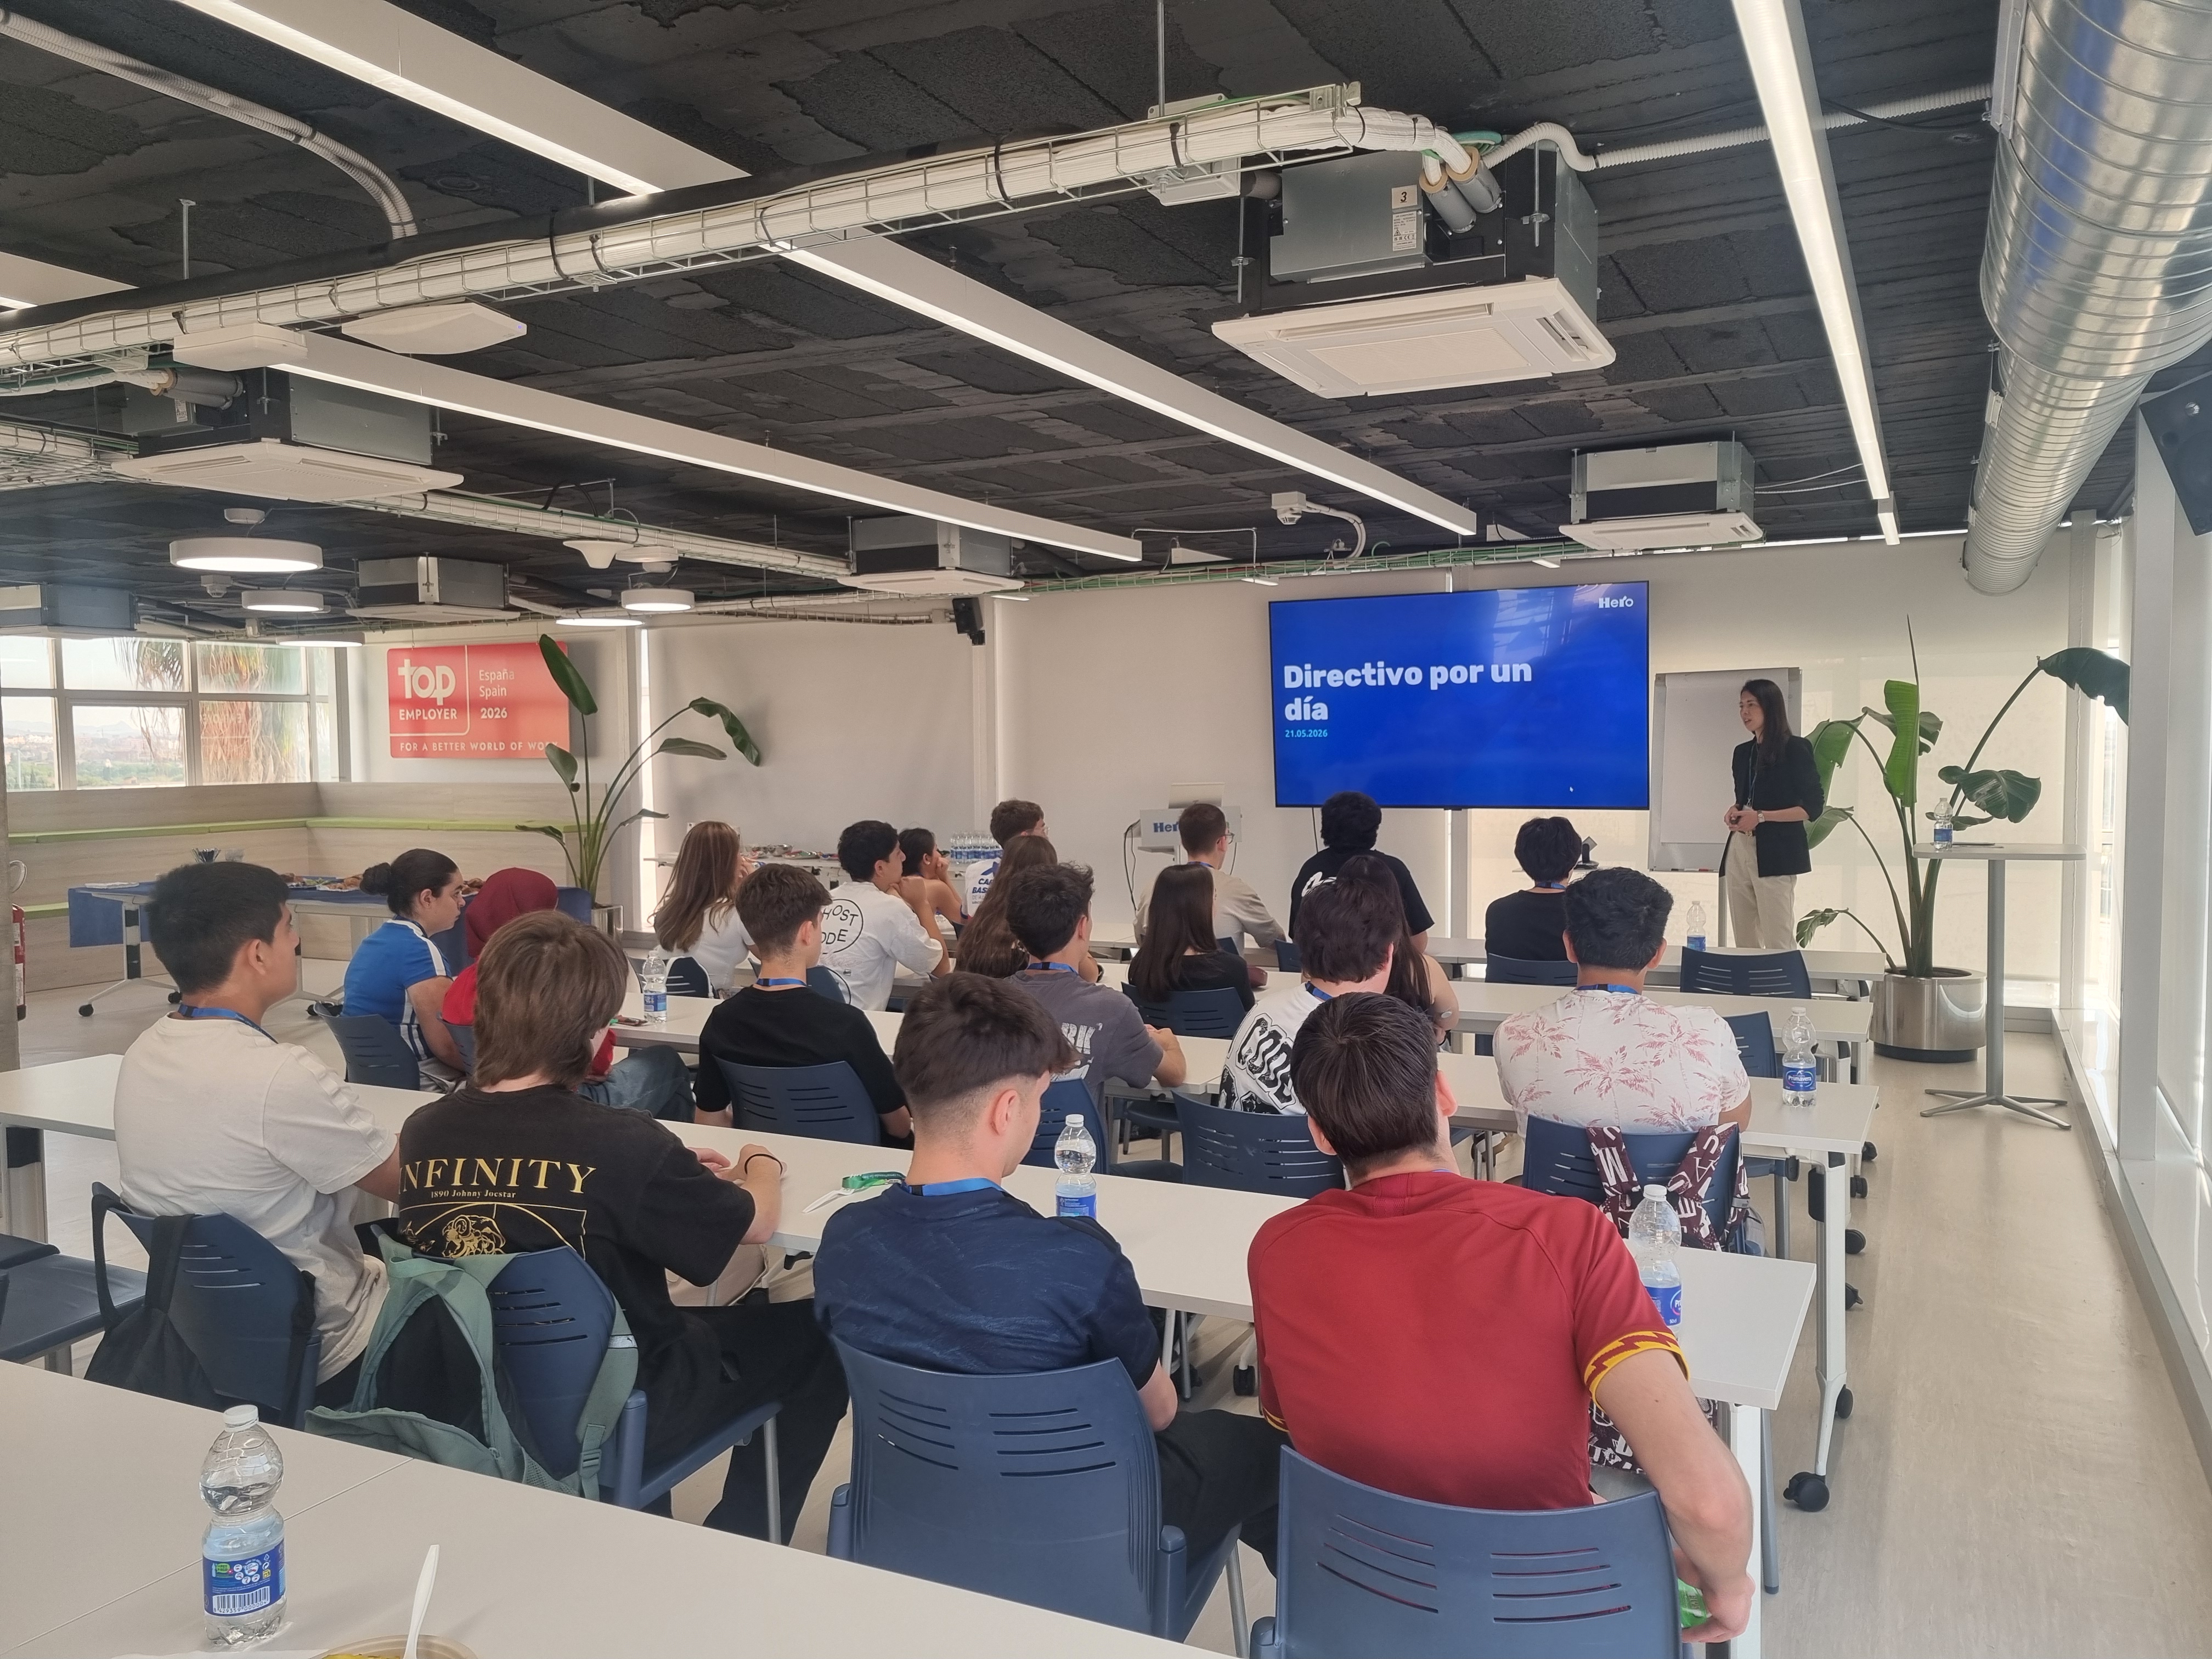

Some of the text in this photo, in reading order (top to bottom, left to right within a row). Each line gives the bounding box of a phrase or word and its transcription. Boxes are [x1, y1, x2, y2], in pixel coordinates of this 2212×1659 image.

[1400, 191, 1407, 202] 3
[1599, 595, 1633, 608] Hero
[479, 668, 515, 684] España
[1284, 661, 1532, 690] Directivo por un
[398, 659, 456, 706] top
[479, 685, 507, 699] Spain
[399, 708, 457, 720] EMPLOYER
[481, 708, 507, 719] 2026
[1285, 696, 1328, 721] día
[1285, 729, 1328, 738] 21.05.2026
[400, 742, 418, 752] FOR
[422, 742, 428, 752] A
[433, 742, 466, 752] BETTER
[470, 742, 505, 751] WORLD
[510, 742, 523, 751] OF
[1153, 821, 1180, 833] Her
[823, 905, 859, 926] HOST
[431, 1190, 449, 1198] 1890
[452, 1189, 481, 1198] Johnny
